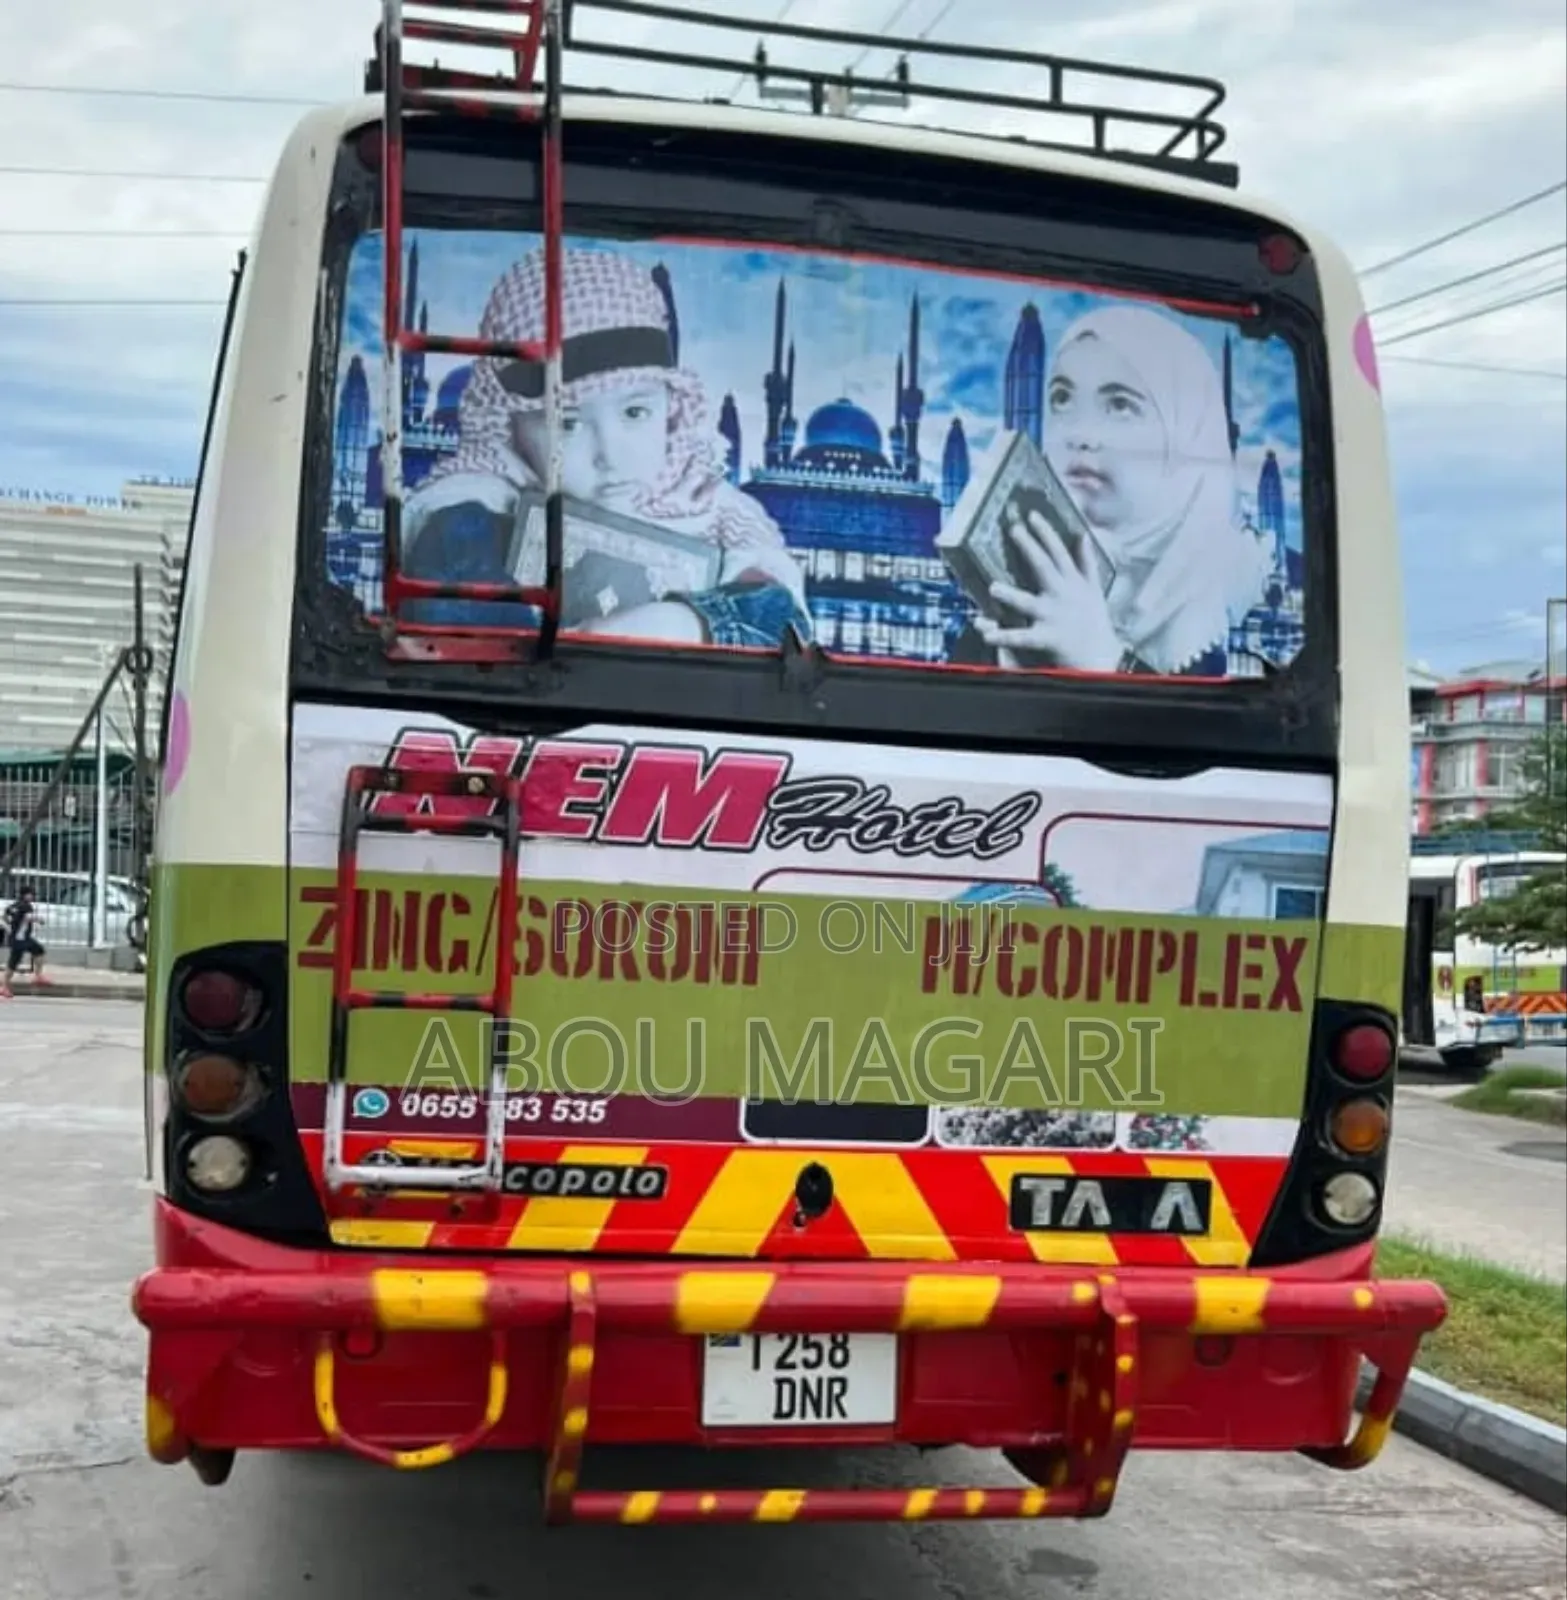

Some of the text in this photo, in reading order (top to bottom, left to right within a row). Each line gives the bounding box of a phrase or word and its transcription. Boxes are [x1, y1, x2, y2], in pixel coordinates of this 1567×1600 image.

[360, 727, 1041, 860] NEM Hotel
[922, 912, 1309, 1012] M/COMPLEX
[401, 1093, 606, 1123] 0655 83 535
[774, 1333, 850, 1370] 258
[773, 1376, 848, 1419] DNR
